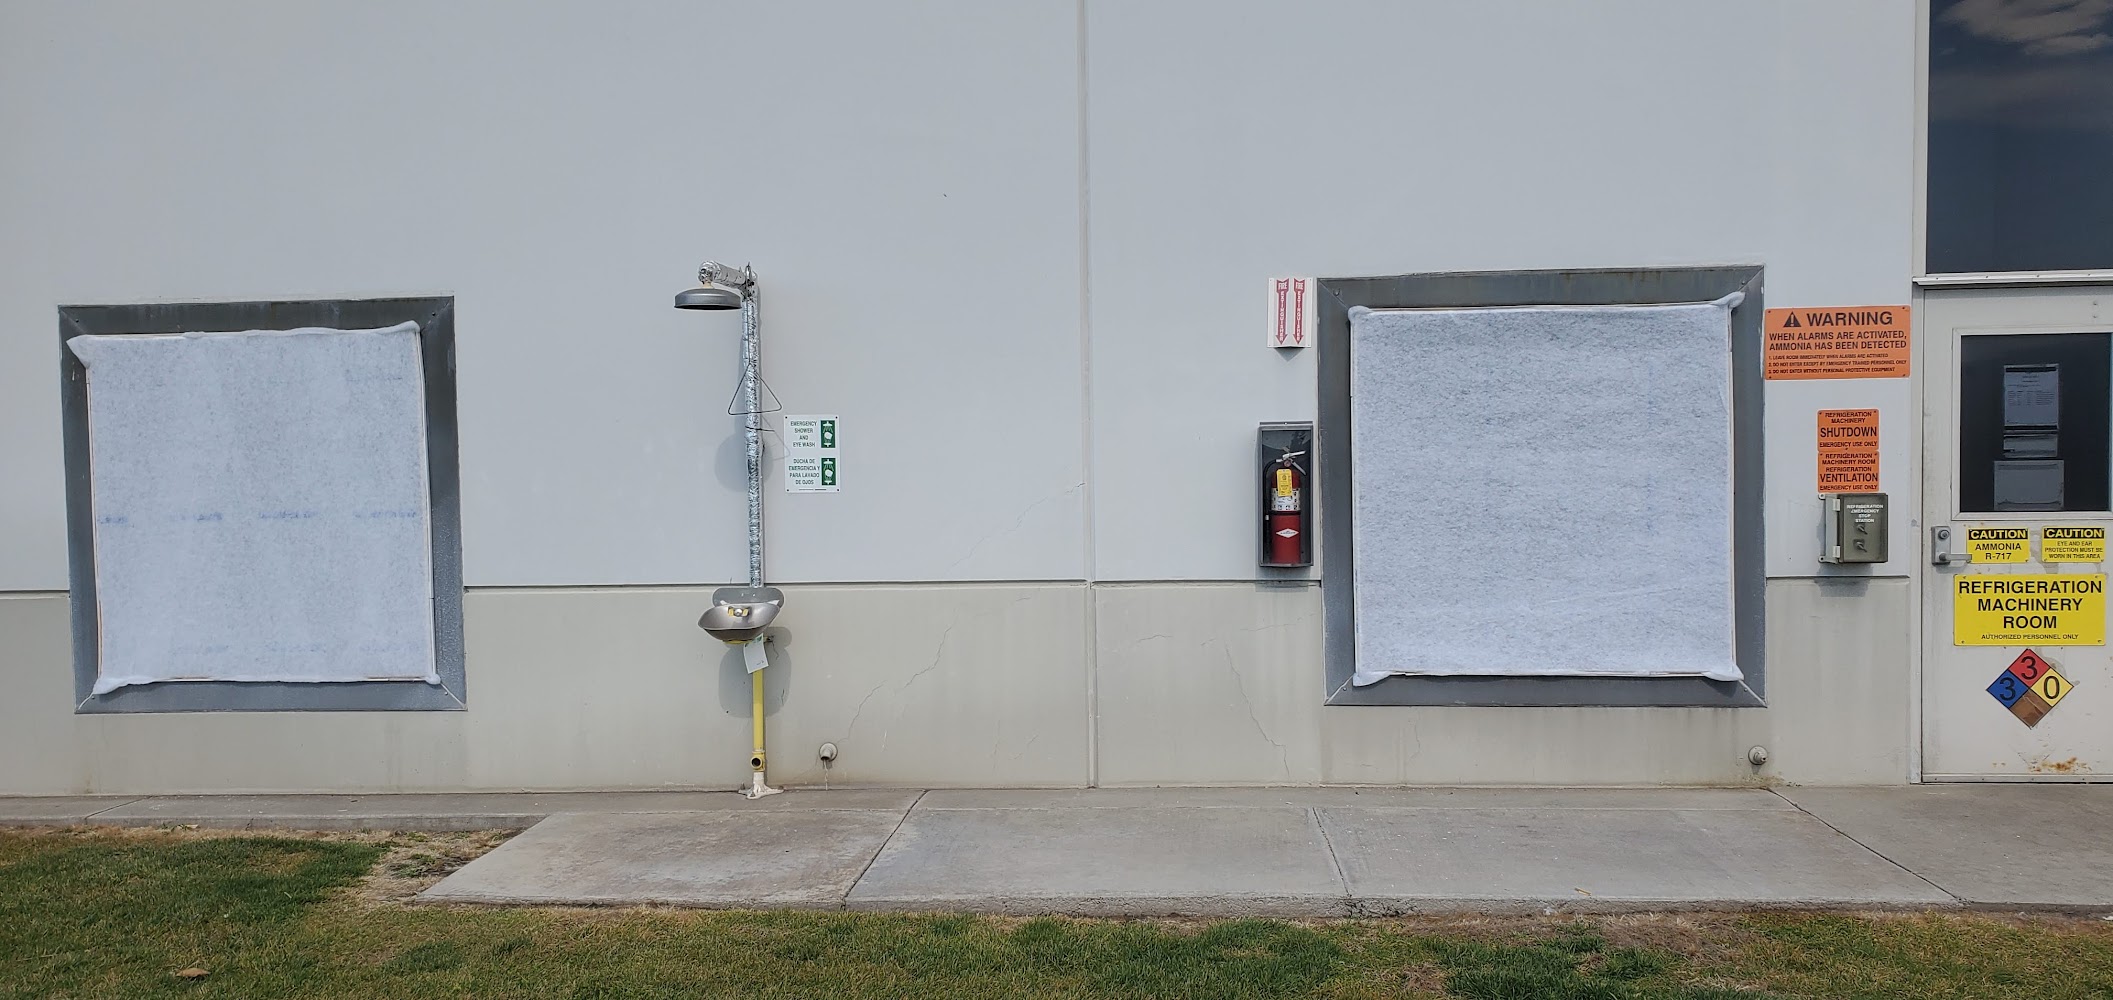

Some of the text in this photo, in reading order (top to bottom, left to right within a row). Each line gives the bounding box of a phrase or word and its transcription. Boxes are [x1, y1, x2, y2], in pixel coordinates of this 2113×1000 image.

[1806, 311, 1892, 327] WARNING
[1769, 330, 1907, 341] WHEN ALARMS ARE ACTIVATED,
[1769, 340, 1907, 351] AMMONIA HAS BEEN DETECTED
[1820, 426, 1877, 438] SHUTDOWN
[1820, 472, 1878, 483] VENTILATION
[1970, 529, 2027, 540] CAUTION
[2045, 528, 2103, 539] CAUTION
[1975, 543, 2022, 551] AMMONIA
[1985, 552, 2012, 560] R-717
[1958, 580, 2102, 594] REFRIGERATION
[1978, 598, 2083, 612] MACHINERY
[2003, 615, 2057, 629] ROOM
[2020, 655, 2038, 680] 3
[1999, 677, 2016, 701] 3
[2043, 675, 2060, 700] 0
